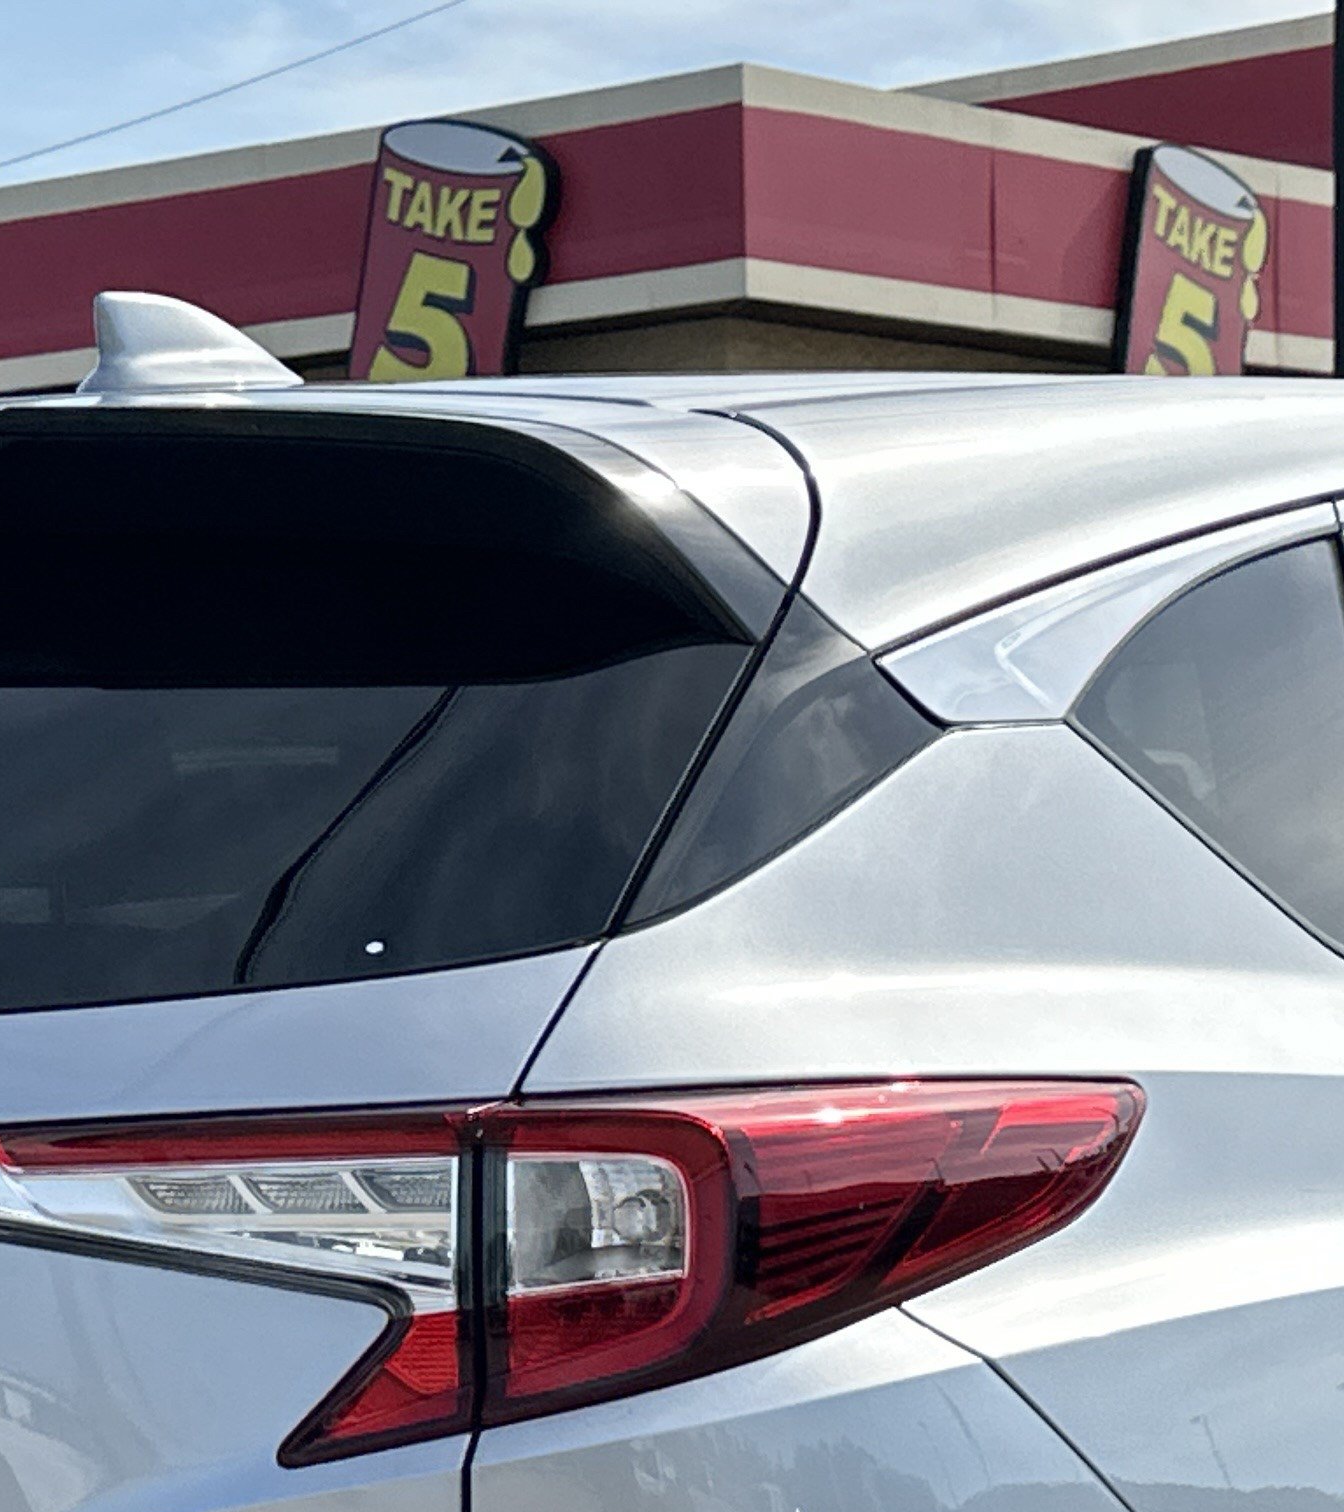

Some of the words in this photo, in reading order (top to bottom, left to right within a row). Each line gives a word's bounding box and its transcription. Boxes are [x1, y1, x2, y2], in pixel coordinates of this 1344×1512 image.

[383, 167, 501, 242] TAKE
[1152, 184, 1238, 277] TAKE
[369, 252, 475, 380] 5
[1145, 273, 1218, 376] 5
